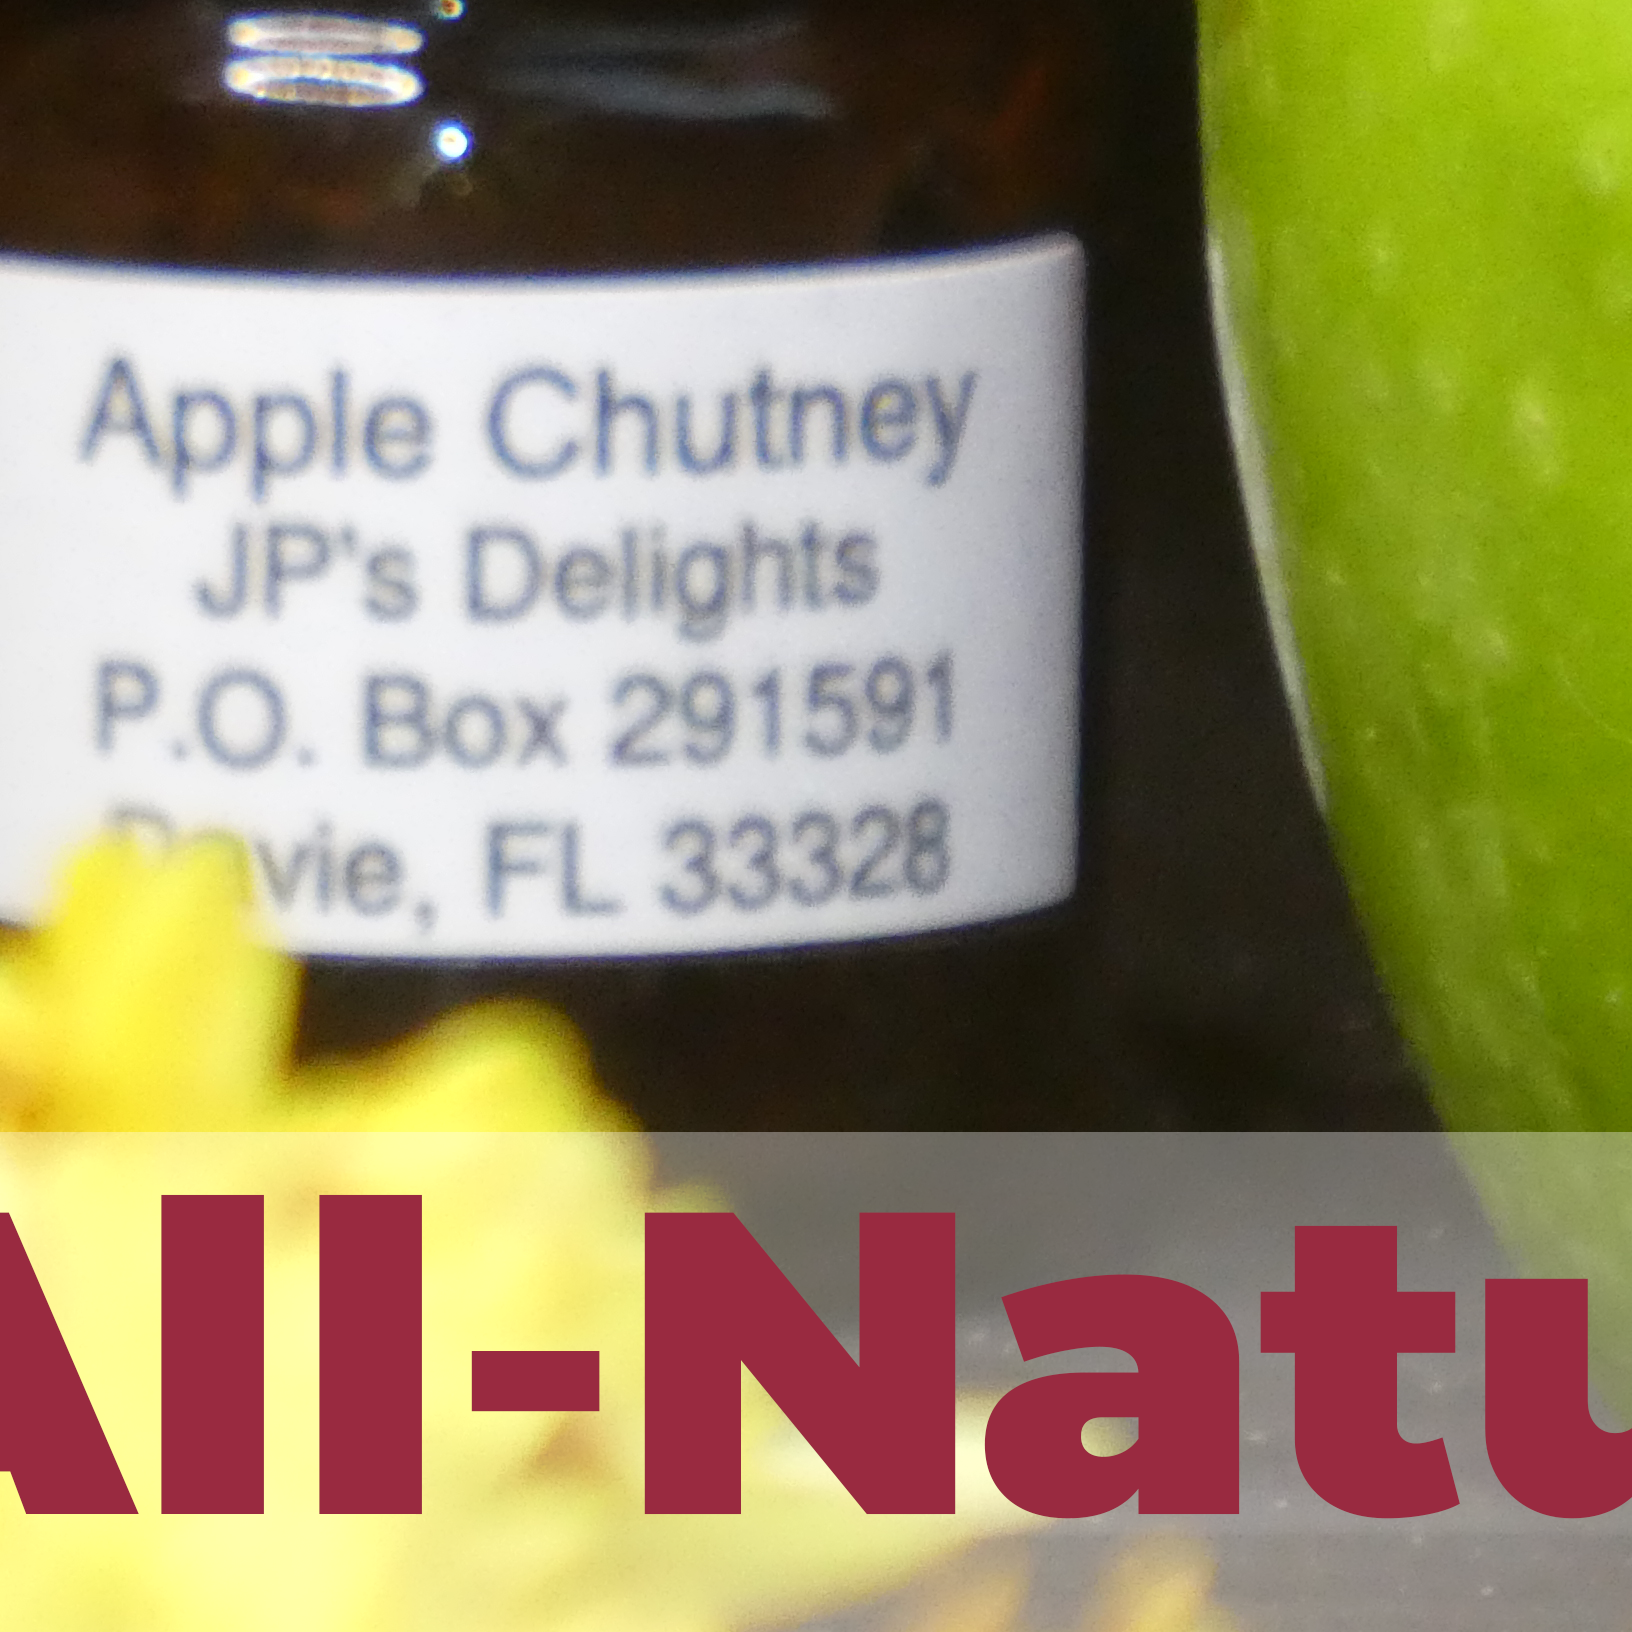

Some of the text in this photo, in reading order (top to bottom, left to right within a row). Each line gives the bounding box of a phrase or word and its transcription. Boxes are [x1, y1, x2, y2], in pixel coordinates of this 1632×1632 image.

[79, 356, 977, 499] Apple Chutney
[193, 518, 881, 640] JP's Delights
[94, 651, 955, 770] P.O. Box 291591
[486, 823, 623, 920] FL
[659, 797, 952, 914] 33328
